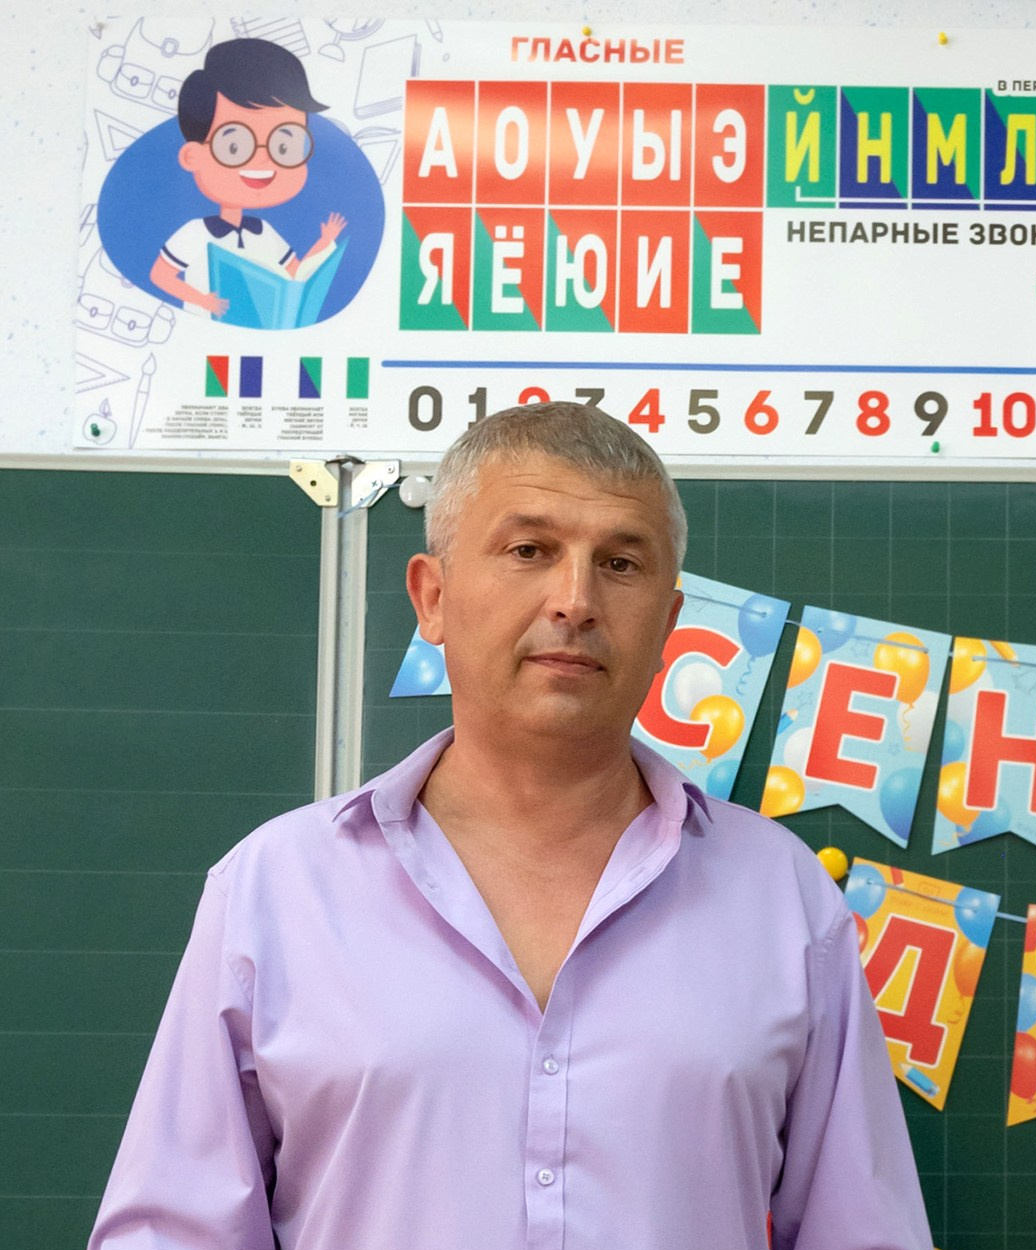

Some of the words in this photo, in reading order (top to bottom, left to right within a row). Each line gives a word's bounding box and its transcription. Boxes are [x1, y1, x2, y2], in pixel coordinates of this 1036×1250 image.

[510, 35, 686, 65] ГЛАСНЫЕ
[998, 80, 1008, 92] В
[418, 106, 458, 178] А
[492, 105, 531, 180] О
[565, 108, 604, 180] У
[631, 109, 682, 181] Ы
[712, 108, 747, 183] Э
[785, 88, 820, 182] Й
[857, 112, 891, 184] Н
[927, 113, 967, 184] М
[787, 220, 960, 246] НЕПАРНЫЕ
[417, 232, 455, 305] Я
[490, 225, 526, 314] Ё
[554, 233, 608, 310] Ю
[635, 235, 673, 309] И
[709, 236, 744, 310] Е
[408, 385, 443, 432] 0
[627, 387, 666, 434] 4
[687, 389, 721, 435] 5
[743, 389, 780, 436] 6
[804, 390, 834, 435] 7
[855, 389, 891, 437] 8
[913, 390, 949, 437] 9
